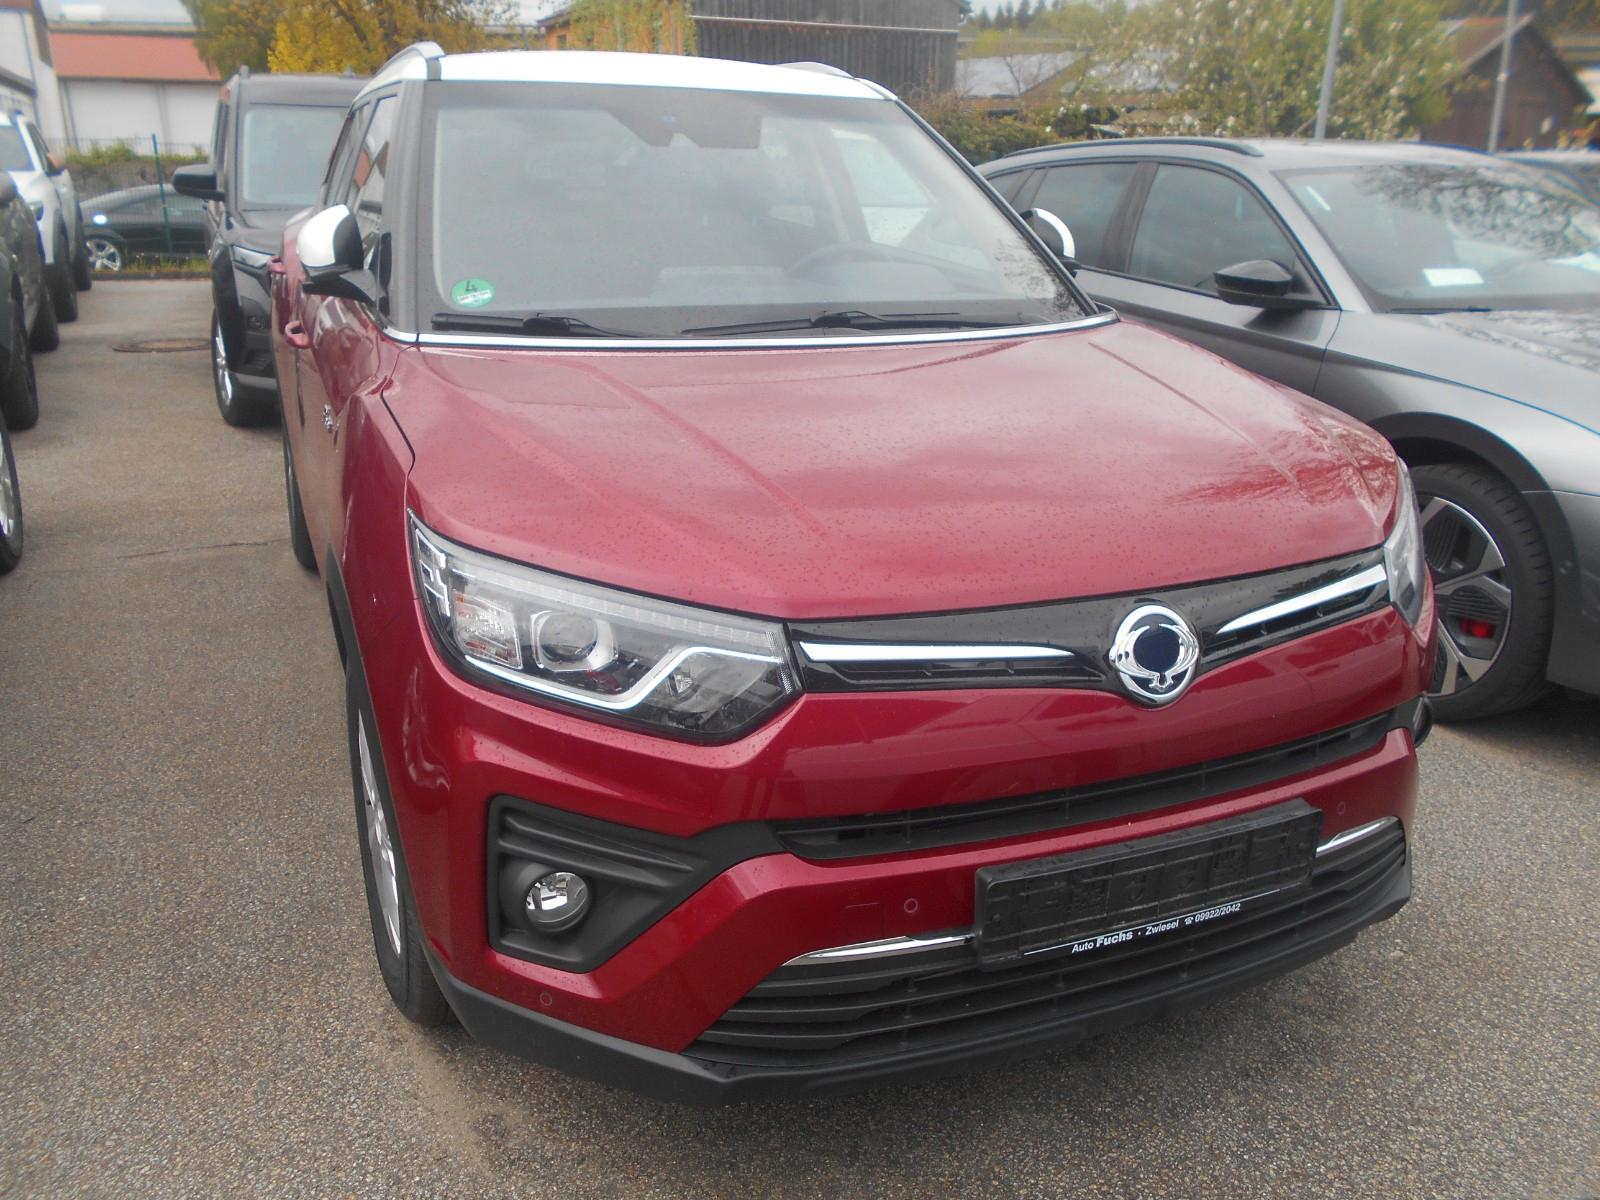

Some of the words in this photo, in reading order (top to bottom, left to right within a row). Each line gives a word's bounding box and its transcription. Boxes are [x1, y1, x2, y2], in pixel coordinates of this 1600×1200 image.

[465, 279, 478, 292] 4
[1072, 941, 1094, 953] Auto
[1096, 931, 1133, 947] Fuchs
[1145, 919, 1179, 936] Zwiesel
[1195, 903, 1241, 923] 09922/2042
